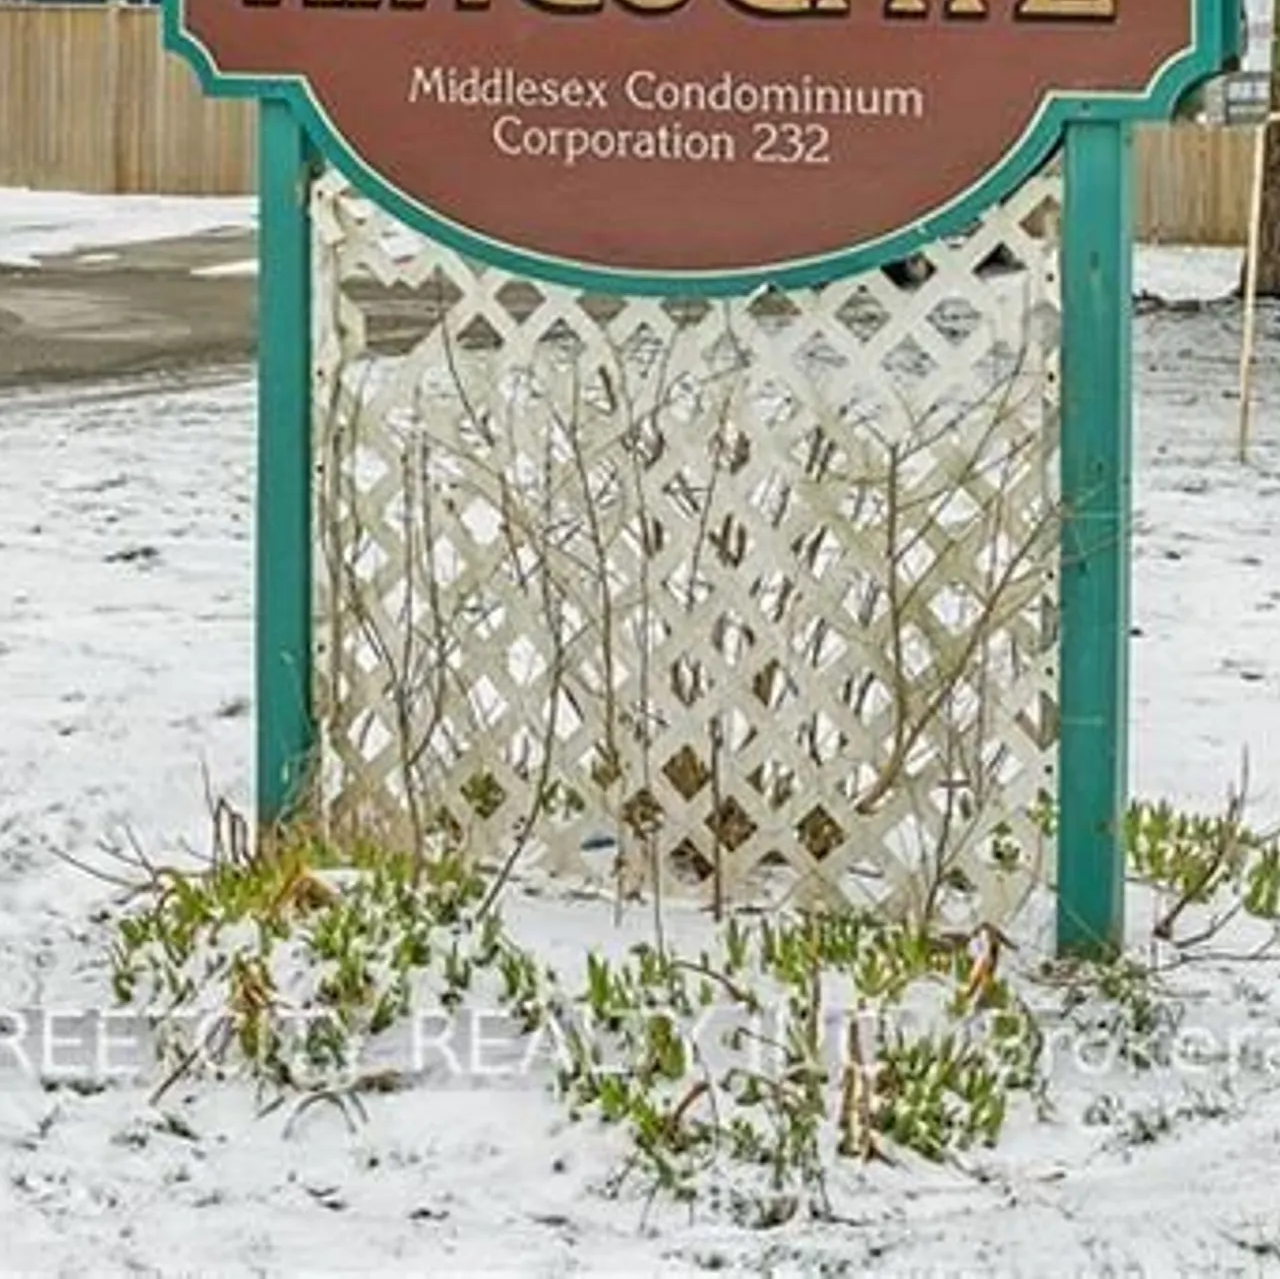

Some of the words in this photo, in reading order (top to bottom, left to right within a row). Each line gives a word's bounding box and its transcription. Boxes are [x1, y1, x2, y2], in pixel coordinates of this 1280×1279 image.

[408, 66, 608, 108] Middlesex
[624, 71, 924, 117] Condominium
[492, 115, 736, 164] Corporation
[752, 124, 831, 164] 232
